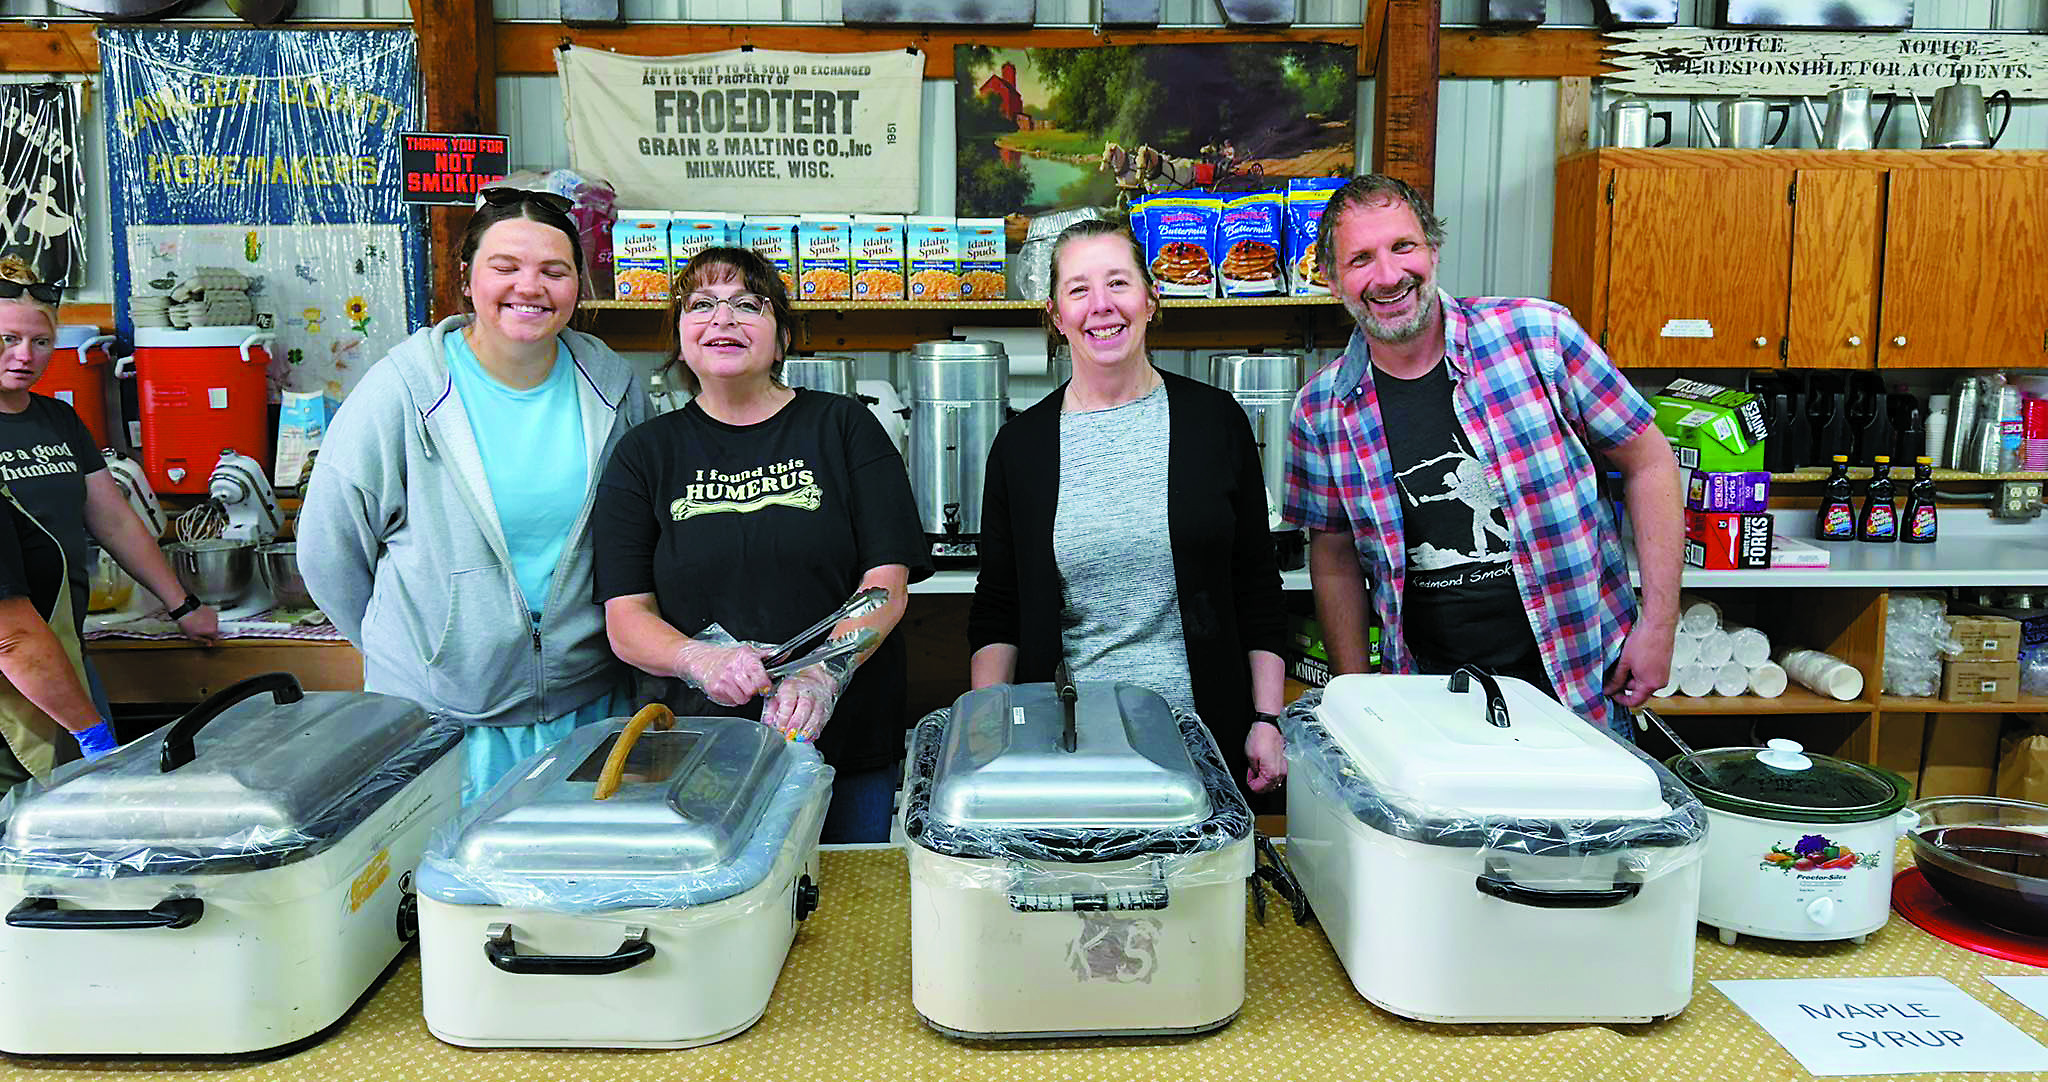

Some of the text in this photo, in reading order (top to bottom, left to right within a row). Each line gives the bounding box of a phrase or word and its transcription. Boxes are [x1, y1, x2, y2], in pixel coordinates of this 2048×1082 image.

[643, 63, 872, 76] THIS BAG NOT TO BE SOLD OR EXCHANGED
[641, 73, 791, 86] AS IT IS THE PROPERTY OF
[654, 88, 860, 134] FROEDTERT
[886, 123, 897, 145] 1951
[407, 136, 504, 154] THANK YOU FOR
[638, 137, 701, 156] GRAIN
[705, 138, 719, 156] &
[724, 137, 809, 156] MALTING
[146, 153, 378, 185] HOMEMAKERS
[434, 152, 476, 173] NOT
[686, 160, 834, 179] MILWAUKEE, WISC.
[1159, 224, 1208, 236] Buttermilk
[624, 233, 657, 246] Idaho
[682, 233, 715, 246] Idaho
[751, 234, 782, 247] Idaho
[809, 235, 840, 247] Idaho
[863, 235, 893, 247] Idaho
[919, 235, 949, 247] Idaho
[967, 238, 997, 249] Idaho
[624, 242, 657, 257] Spuds
[809, 243, 841, 257] Spuds
[862, 244, 894, 258] Spuds
[918, 244, 950, 258] Spuds
[967, 245, 997, 260] Spuds
[1745, 400, 1769, 441] KNIVES
[16, 449, 31, 460] a
[31, 442, 74, 464] good
[0, 461, 72, 481] human
[695, 458, 804, 484] I found this
[685, 469, 815, 501] HUMERUS
[1728, 479, 1737, 505] Forks
[1748, 516, 1769, 566] FORKS
[1295, 661, 1329, 687] KNIVES
[1797, 1003, 1942, 1020] MAPLE
[1836, 1030, 1964, 1049] SYRUP
